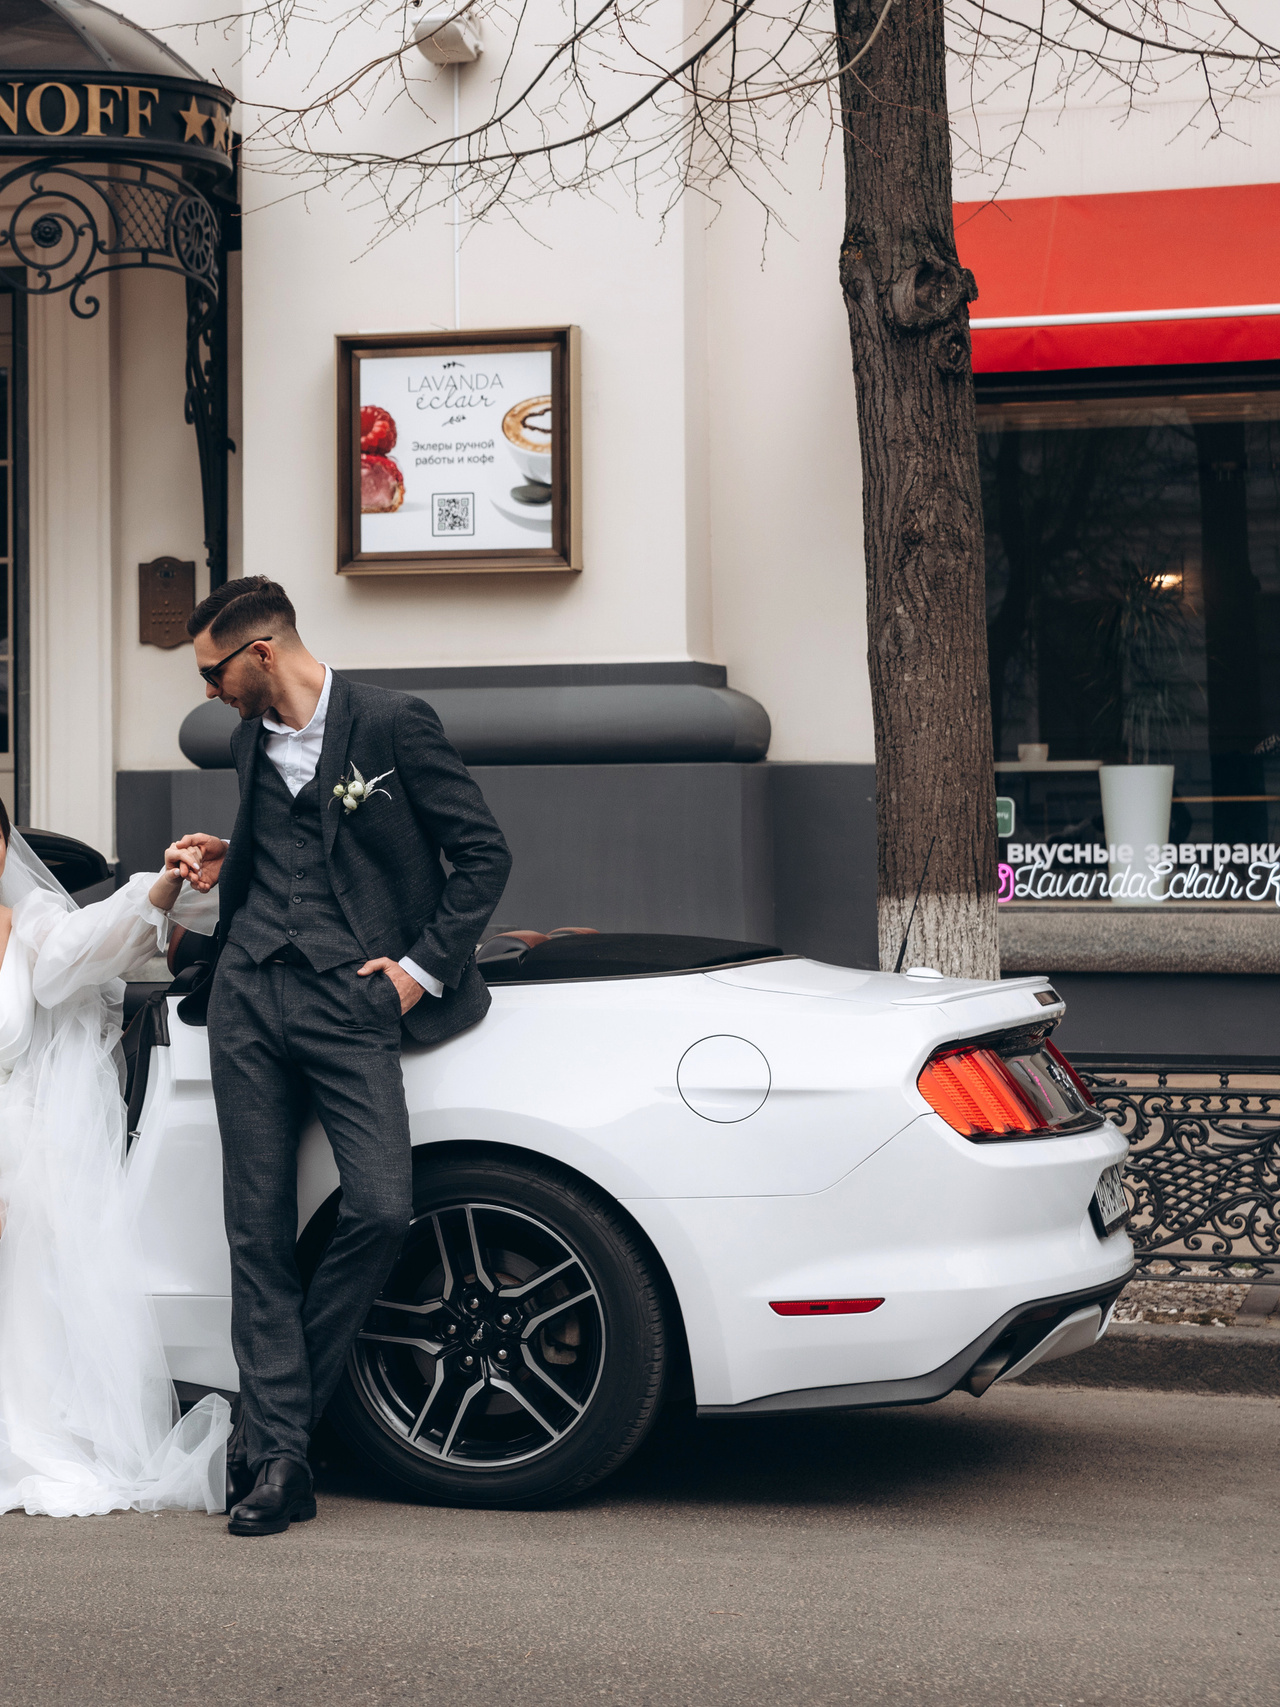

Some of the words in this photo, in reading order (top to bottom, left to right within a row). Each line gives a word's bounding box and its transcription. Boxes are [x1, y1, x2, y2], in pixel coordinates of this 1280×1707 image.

[407, 373, 504, 393] LAVANDA
[416, 386, 496, 410] éclair
[412, 441, 452, 453] Эклеры
[455, 439, 495, 452] ручной
[415, 455, 455, 467] работы
[457, 456, 465, 464] и
[467, 453, 495, 465] кофе
[1007, 843, 1134, 871] вкусные
